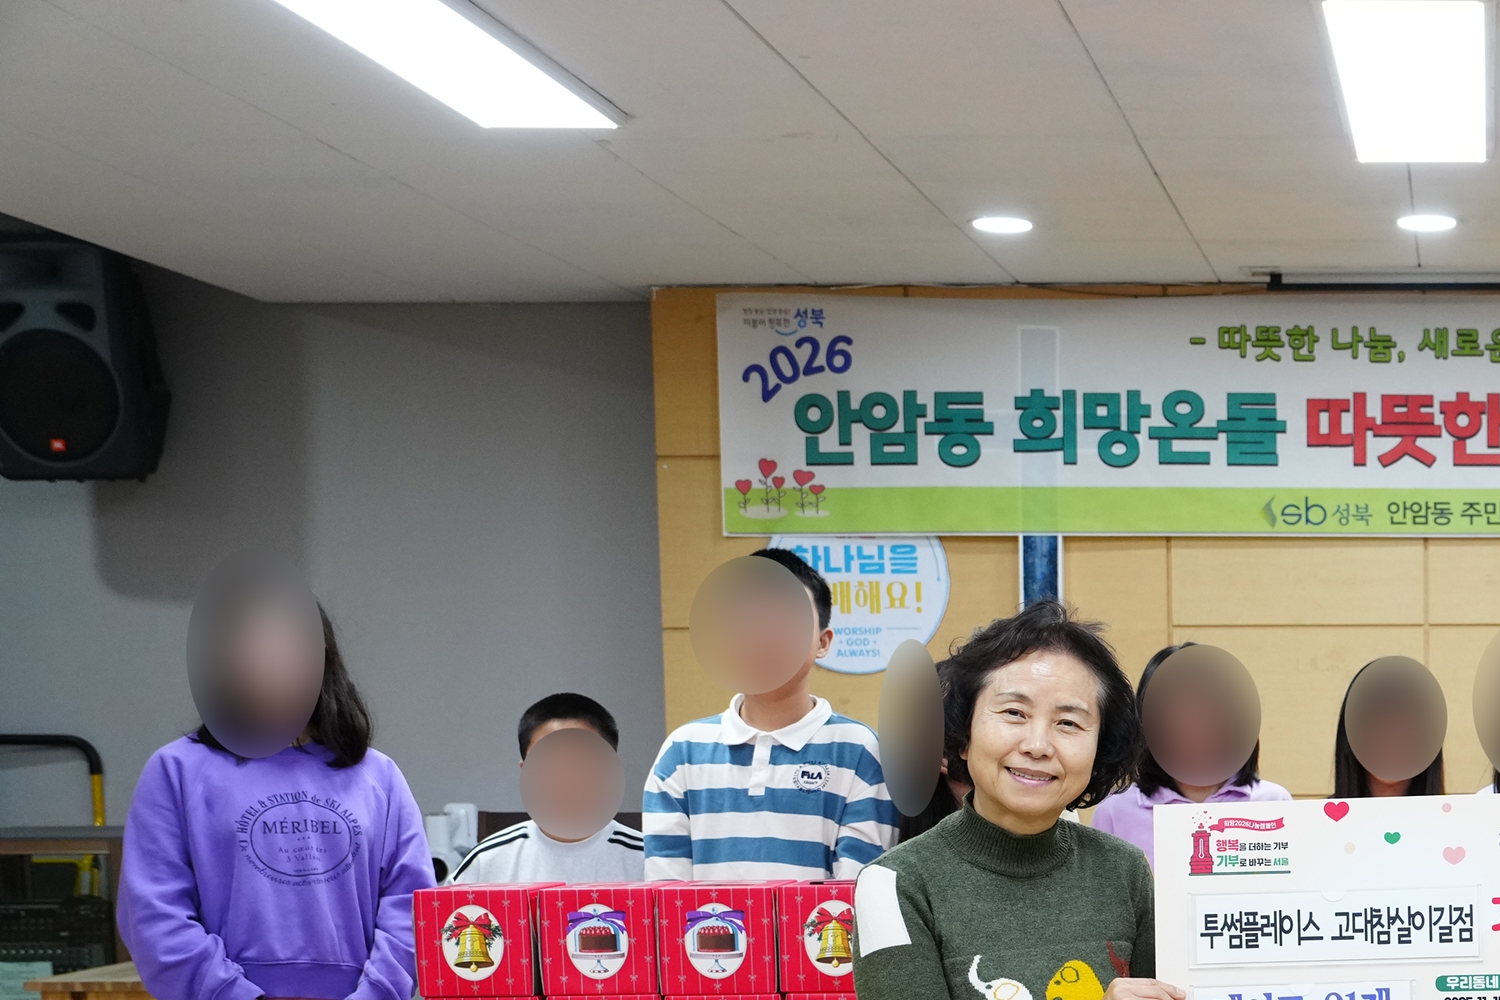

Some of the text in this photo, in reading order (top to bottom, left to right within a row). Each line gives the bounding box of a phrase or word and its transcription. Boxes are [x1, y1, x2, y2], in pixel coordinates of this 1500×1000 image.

[793, 307, 825, 328] 성북
[1218, 325, 1319, 362] 따뜻한
[1331, 326, 1406, 363] 나눔,
[742, 335, 853, 403] 2026
[794, 390, 994, 468] 안암동
[1013, 388, 1287, 468] 희망온돌
[1281, 496, 1373, 527] sb 성북
[1388, 501, 1453, 527] 안암동
[834, 627, 882, 636] WORSHIP
[846, 637, 871, 647] GOD
[836, 648, 881, 658] ALWAYS!
[801, 770, 823, 780] FILA
[266, 790, 309, 806] STATION
[323, 797, 341, 811] SKI
[340, 808, 363, 837] ALPES
[262, 816, 342, 835] MÉRIBEL
[1216, 839, 1289, 852] 행복을 더하는 기부
[1216, 855, 1289, 867] 기부로 바꾸는 서울
[1200, 904, 1474, 949] 투썸플레이스 고대참살이길점
[1446, 975, 1499, 989] 우리동네
